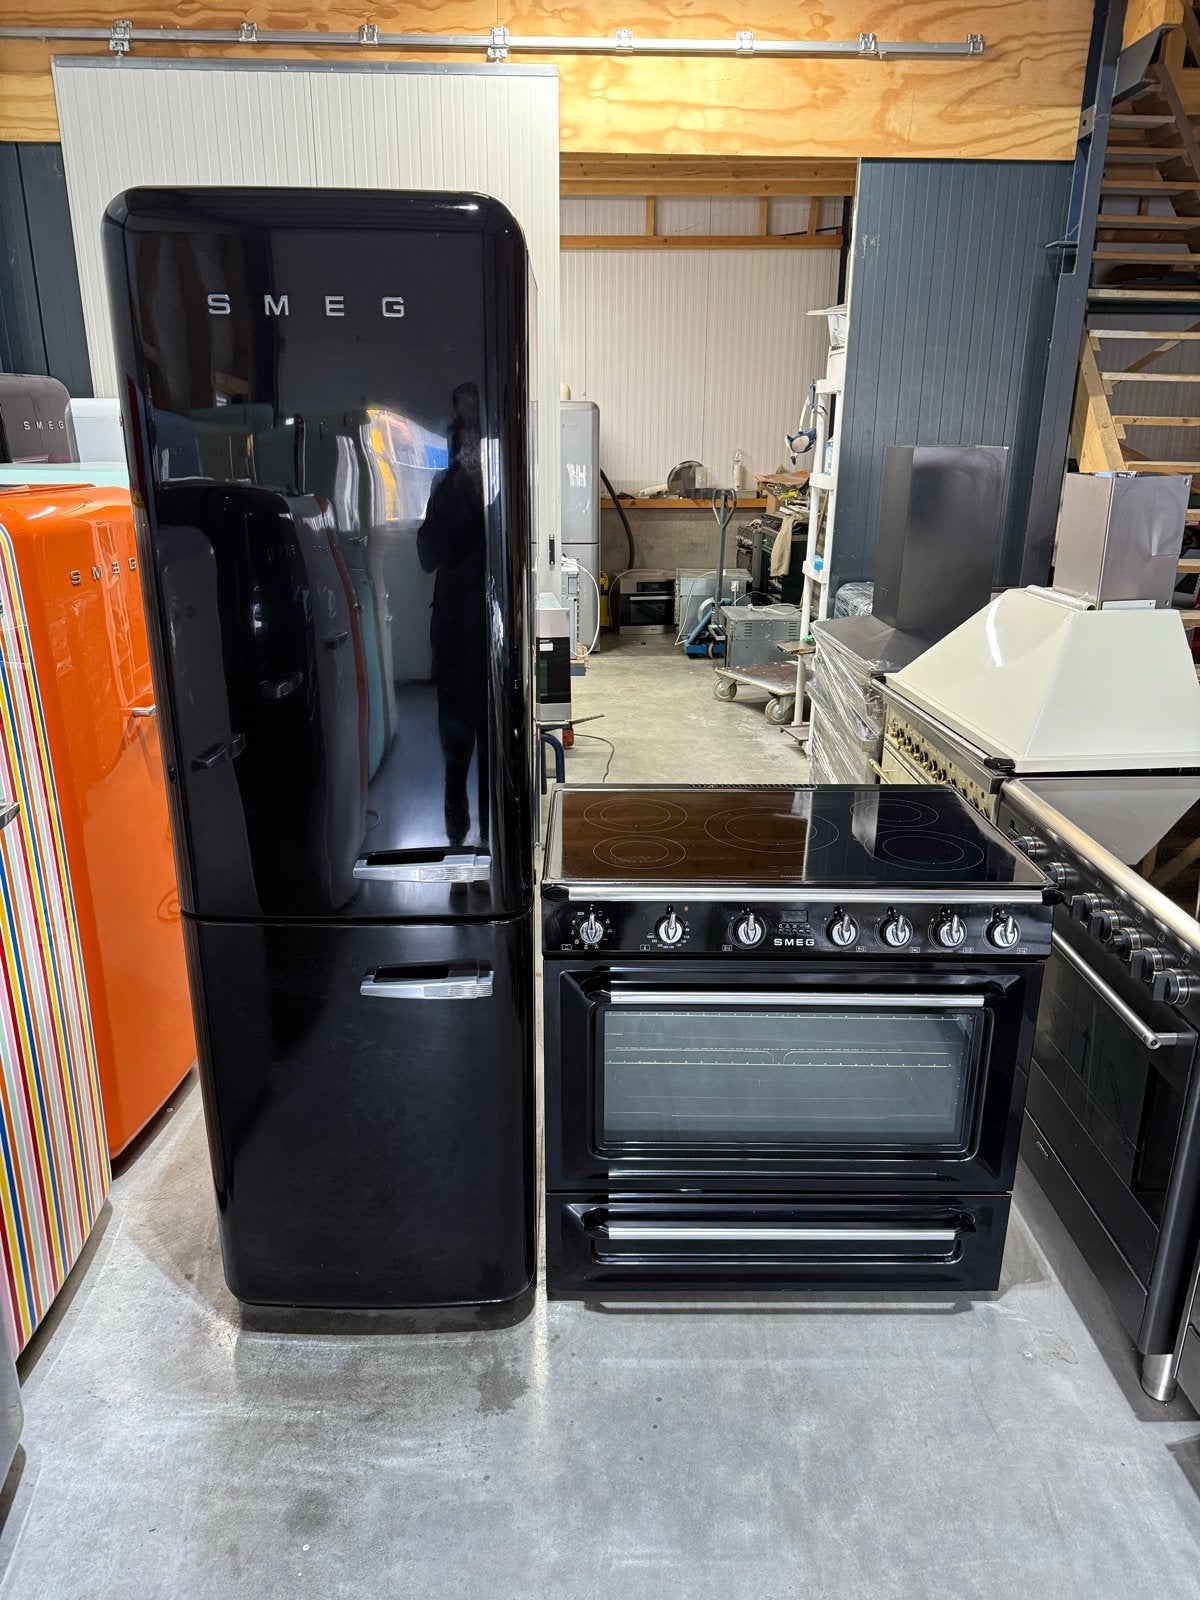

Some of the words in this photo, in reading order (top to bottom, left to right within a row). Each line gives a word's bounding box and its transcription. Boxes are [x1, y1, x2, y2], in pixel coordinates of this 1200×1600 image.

[207, 294, 405, 318] SMEG
[23, 420, 64, 430] SMEG
[70, 557, 137, 586] SMEG
[773, 938, 815, 947] SMEG
